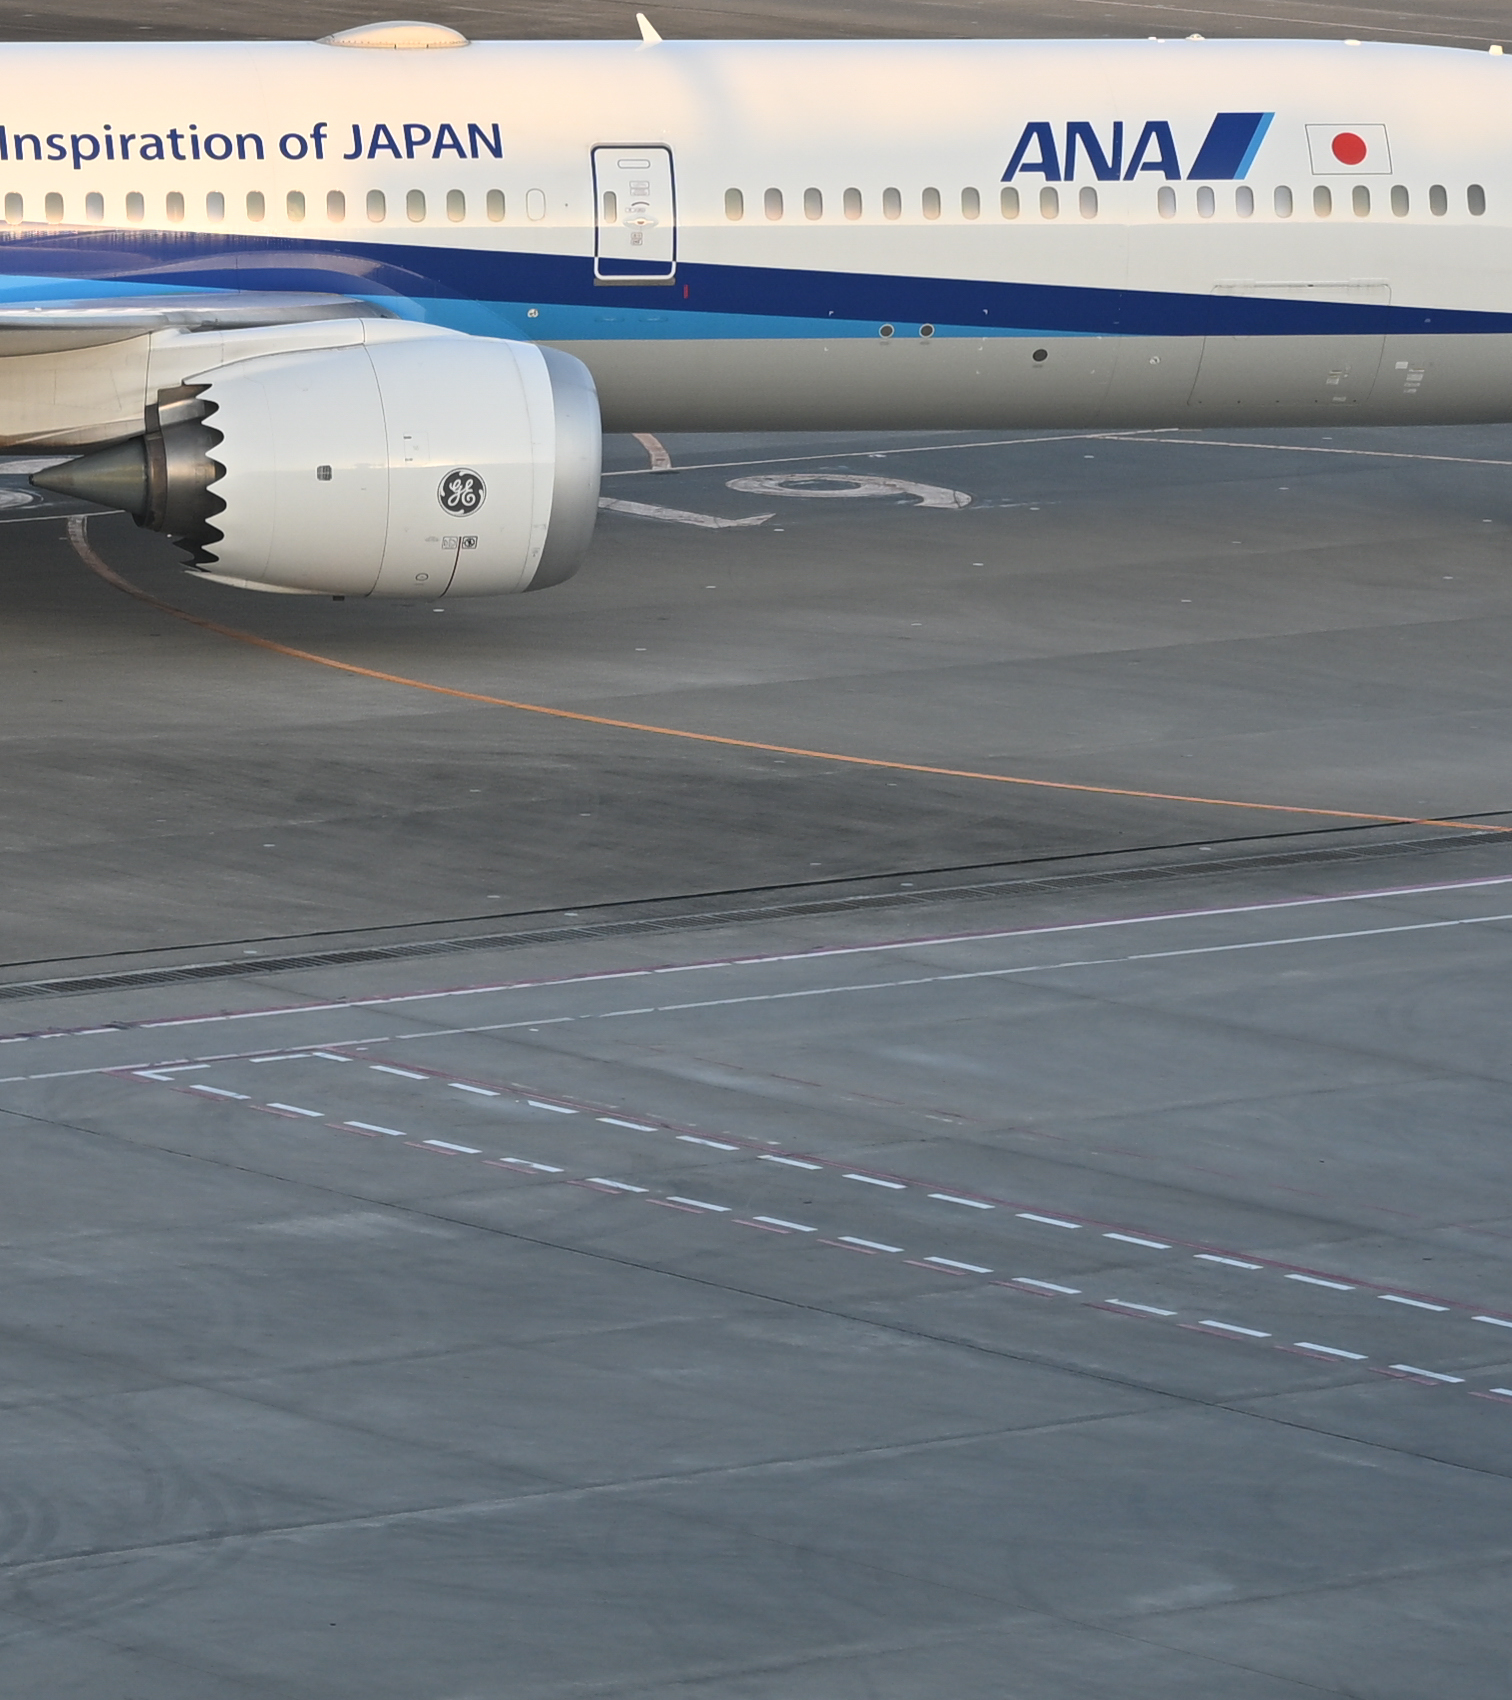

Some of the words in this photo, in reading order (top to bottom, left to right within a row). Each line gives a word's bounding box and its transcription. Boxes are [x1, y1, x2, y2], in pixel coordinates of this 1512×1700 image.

[279, 122, 328, 160] of
[342, 123, 504, 160] JAPAN
[1001, 120, 1181, 181] ANA
